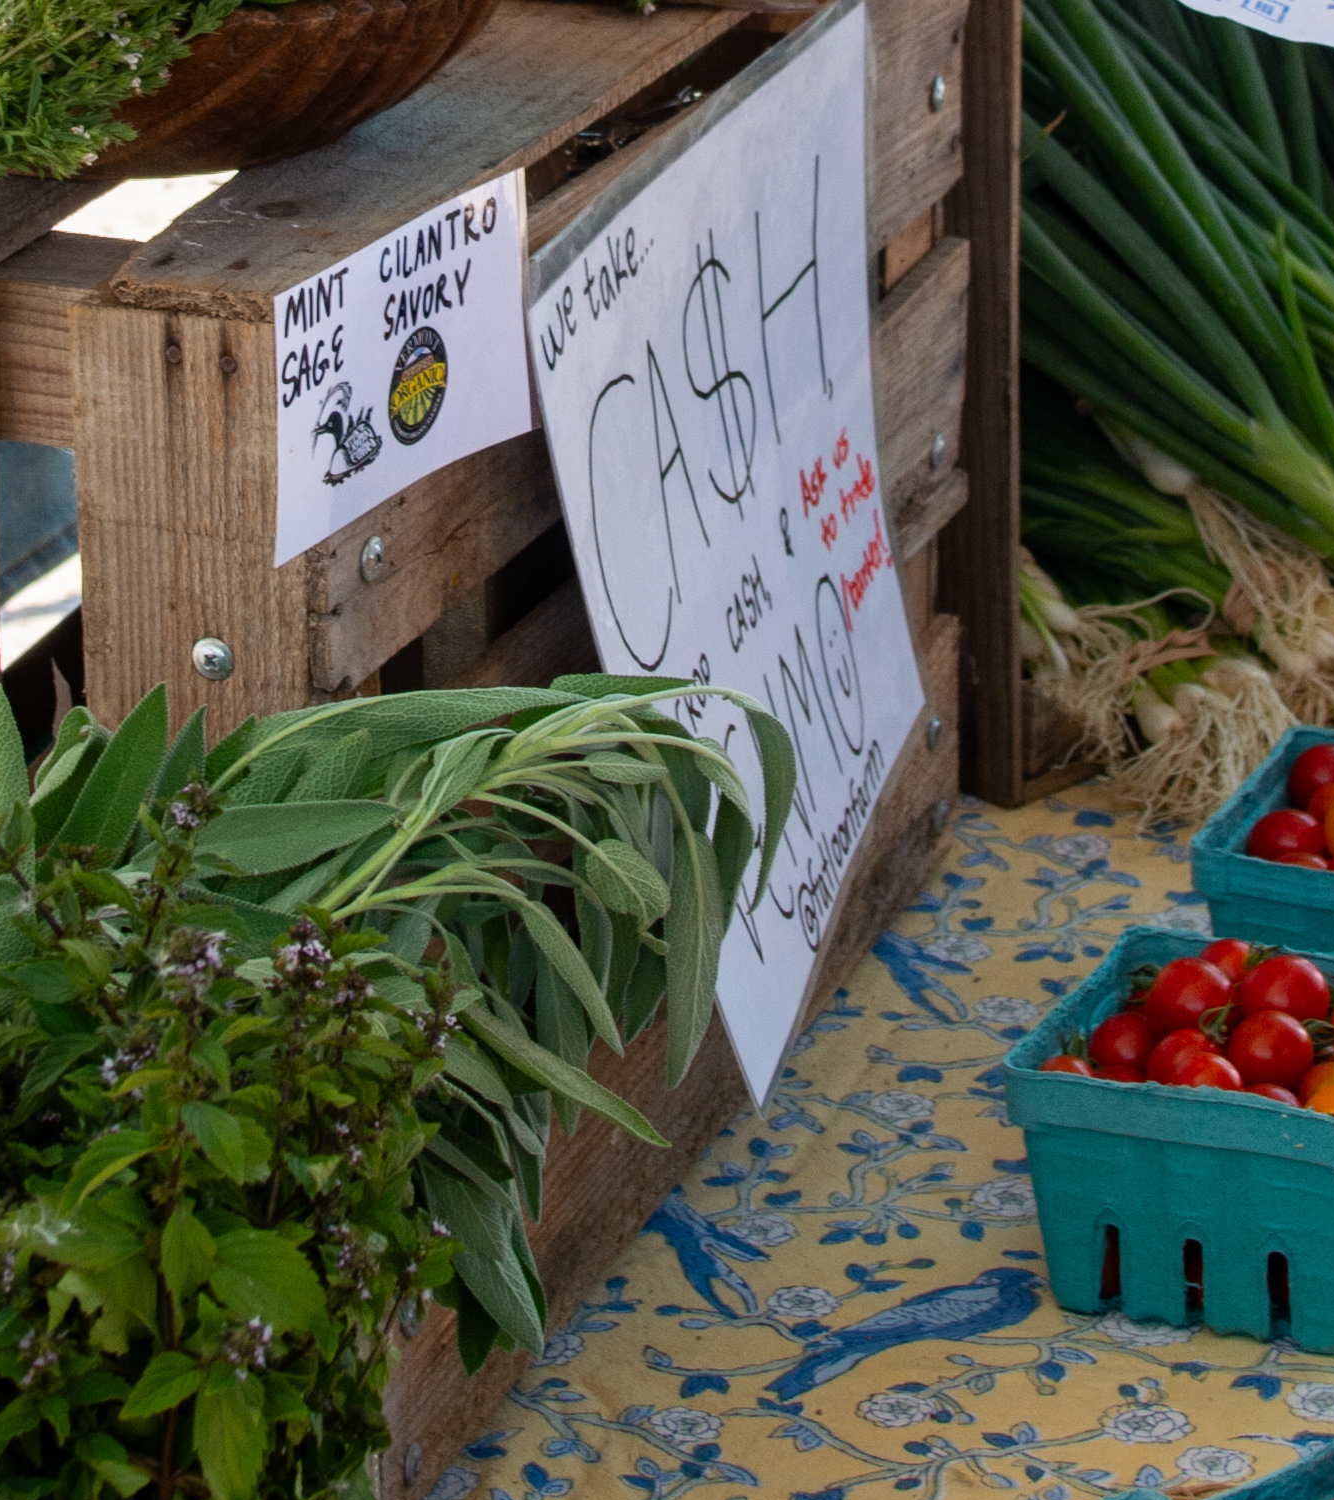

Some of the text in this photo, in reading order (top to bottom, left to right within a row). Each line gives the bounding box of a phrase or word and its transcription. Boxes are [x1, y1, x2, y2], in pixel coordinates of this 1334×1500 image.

[281, 258, 471, 408] SAGE SAVORY
[284, 196, 497, 339] MINT CILANTRO
